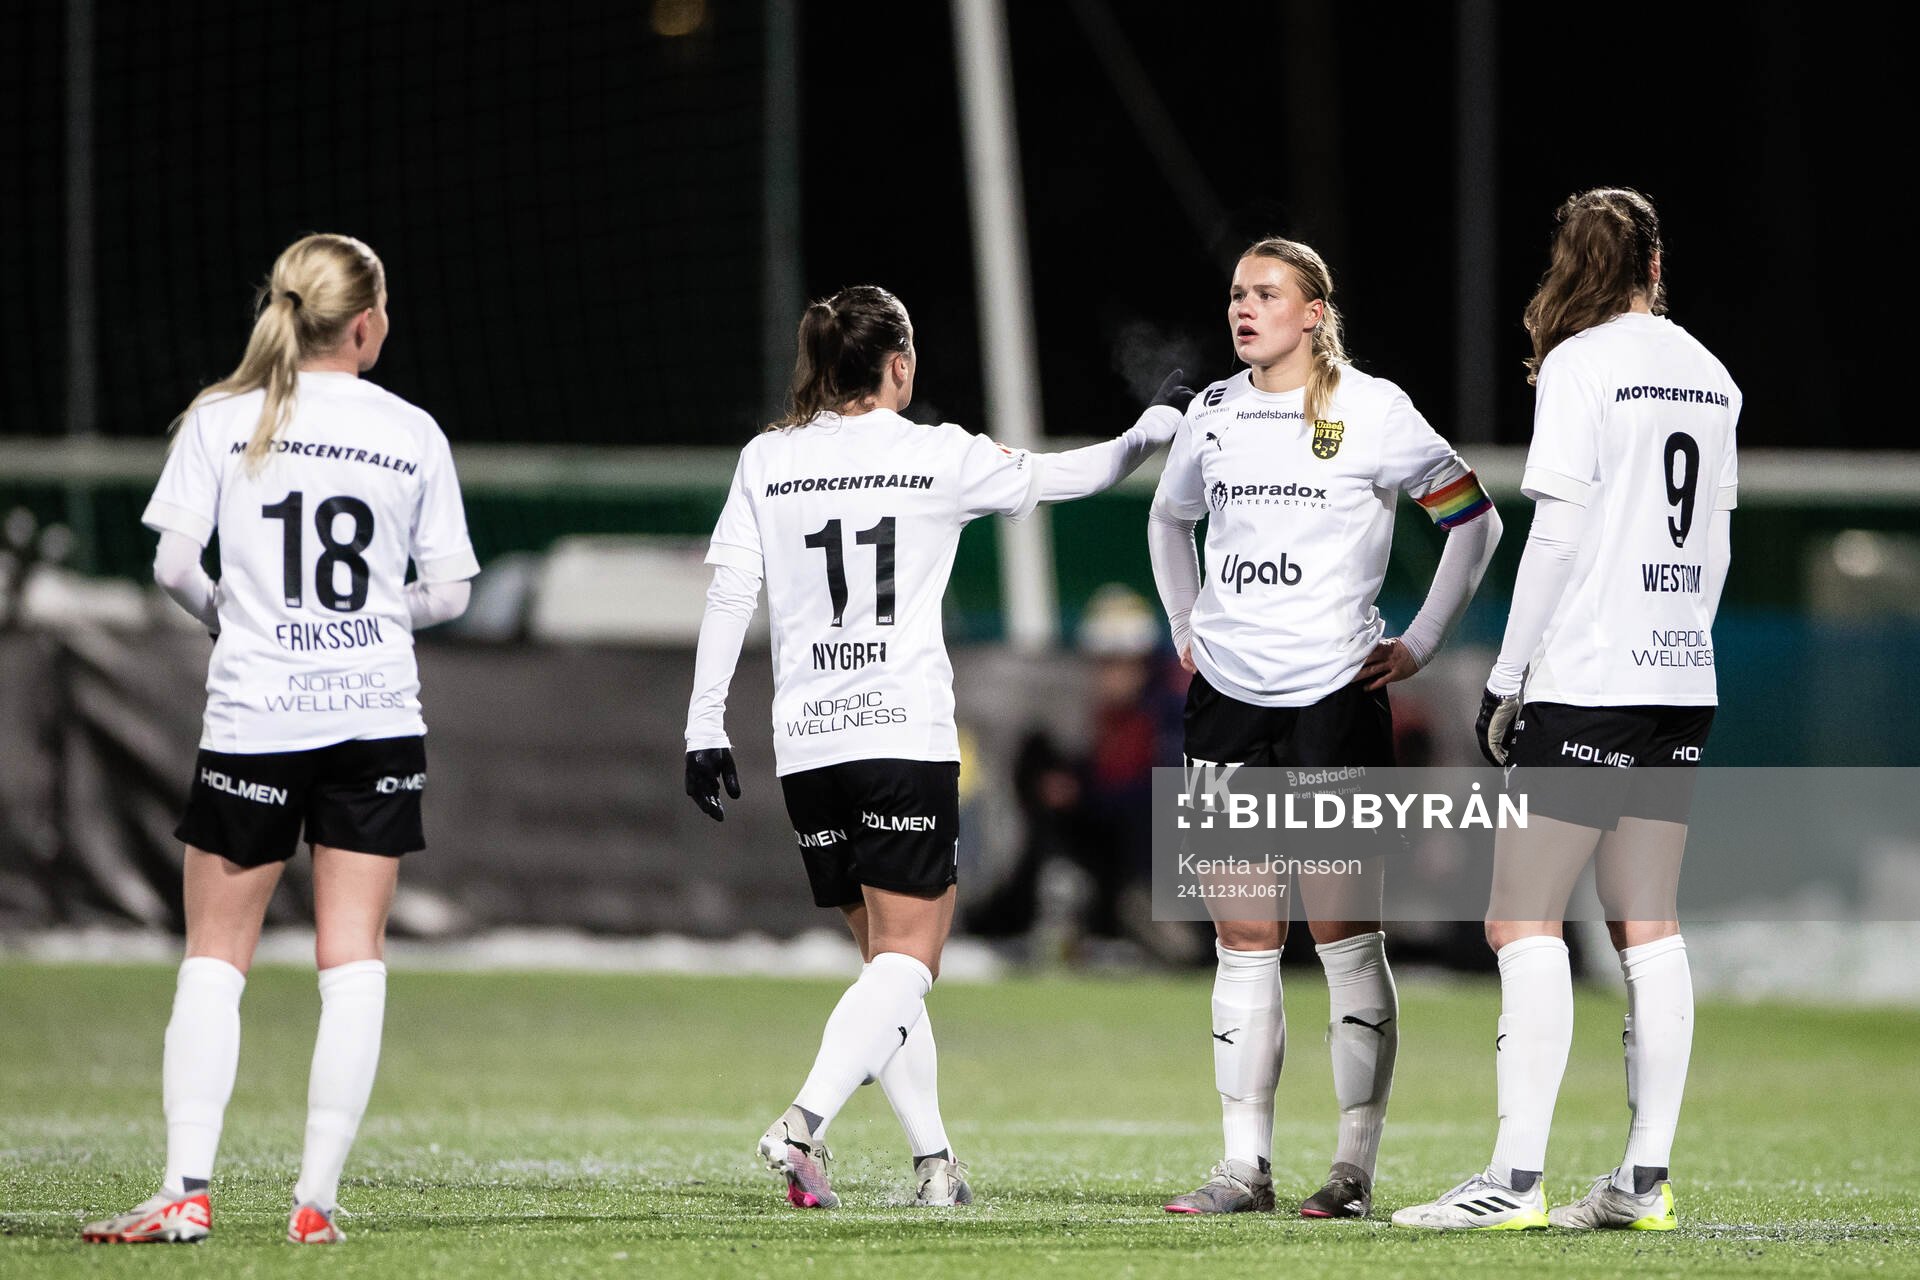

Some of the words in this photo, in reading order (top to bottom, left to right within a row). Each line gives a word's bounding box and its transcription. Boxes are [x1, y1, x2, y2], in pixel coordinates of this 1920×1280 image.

[1615, 386, 1729, 408] MOTORCENTRALEN
[1236, 410, 1305, 420] Handelsbanke
[230, 440, 417, 476] MTORCENTRALEN
[766, 475, 935, 497] MOTORCENTRALEN
[1231, 483, 1327, 500] paradox
[1663, 431, 1700, 549] 9
[1231, 499, 1326, 510] INTERACTIVE
[262, 490, 375, 613] 18
[804, 516, 896, 628] 11
[276, 617, 384, 652] ERIKSSON
[1652, 630, 1707, 648] NORDIC
[289, 671, 386, 692] NORDIC
[265, 691, 406, 712] WELLNESS
[803, 691, 883, 717] NORDIC
[787, 707, 907, 737] WELLNESS
[201, 767, 288, 806] HOLMEN
[1298, 766, 1366, 785] Bostaden
[862, 811, 936, 832] HOLMEN
[795, 829, 848, 848] LMEN
